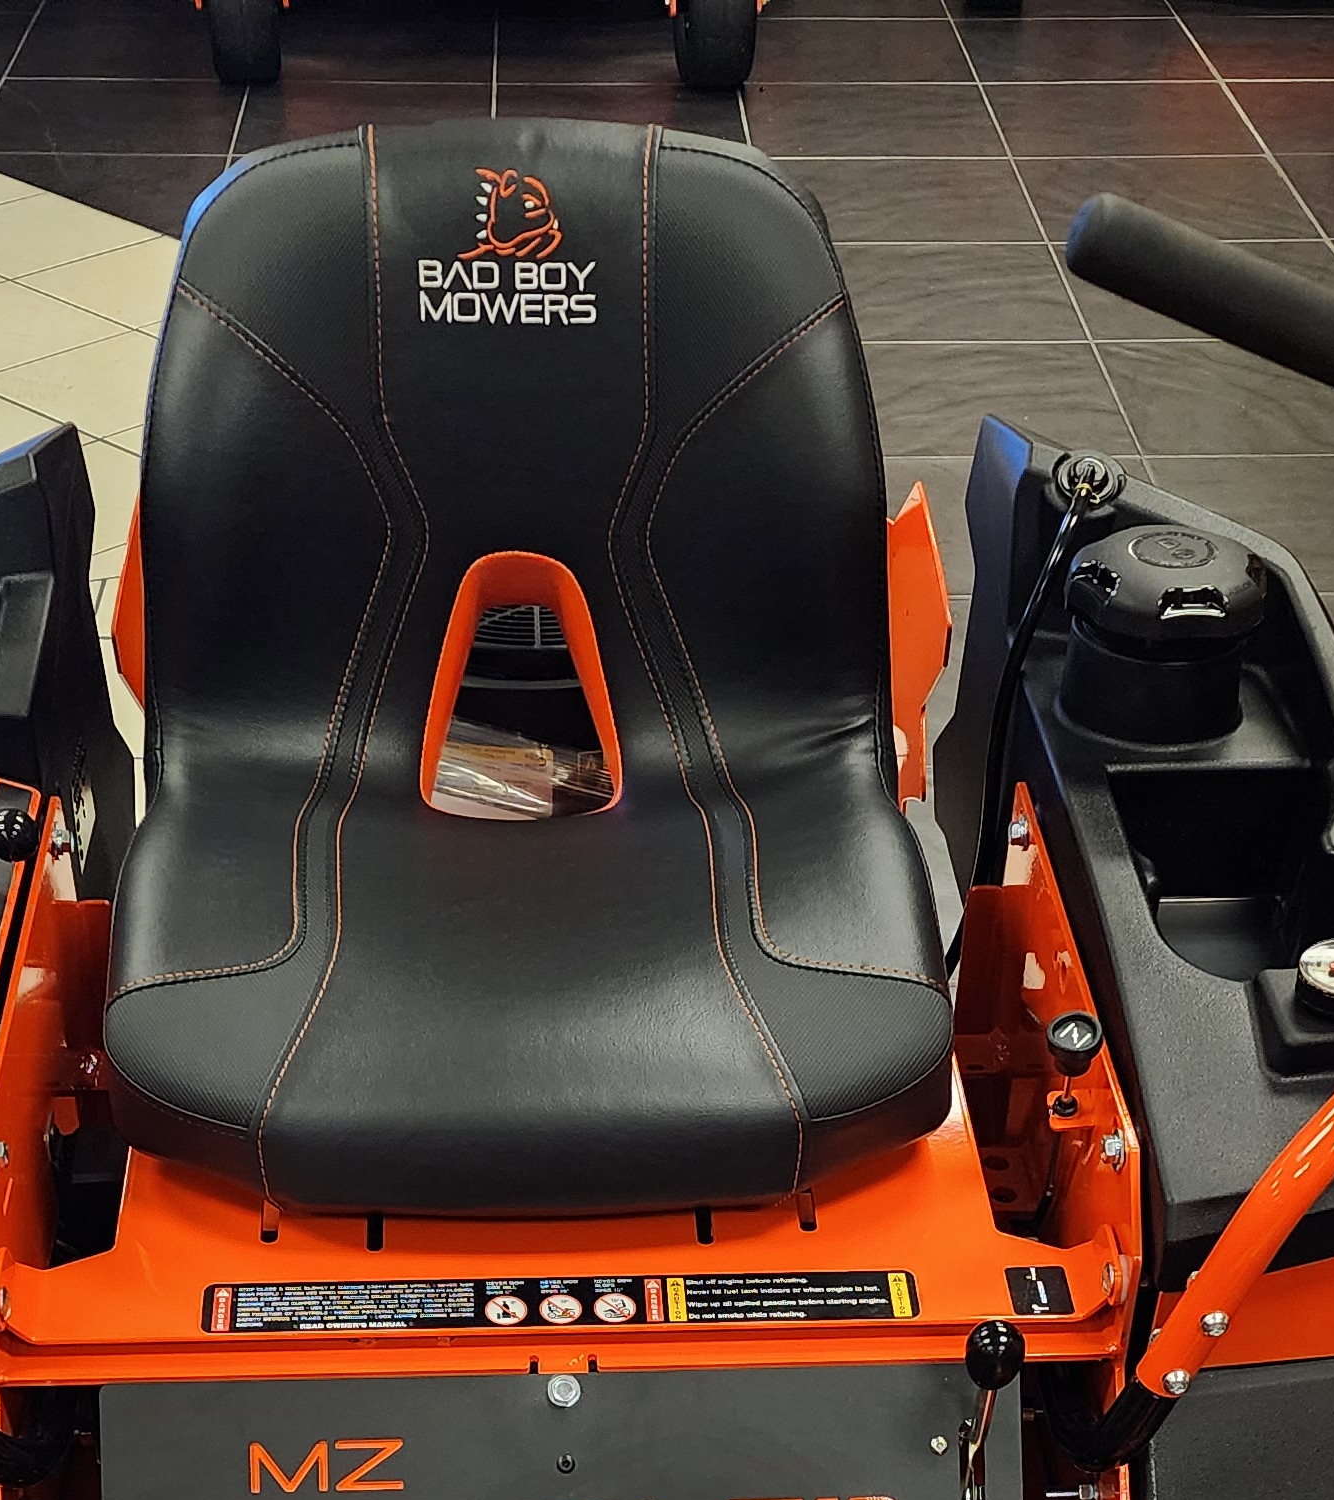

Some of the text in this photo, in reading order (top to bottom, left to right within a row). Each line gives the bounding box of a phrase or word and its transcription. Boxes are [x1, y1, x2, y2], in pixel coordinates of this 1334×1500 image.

[417, 259, 596, 291] BAD BOY
[419, 290, 597, 325] MOWERS
[673, 1287, 682, 1320] CAUTION
[895, 1283, 906, 1315] CAUTION
[248, 1437, 406, 1494] MZ
